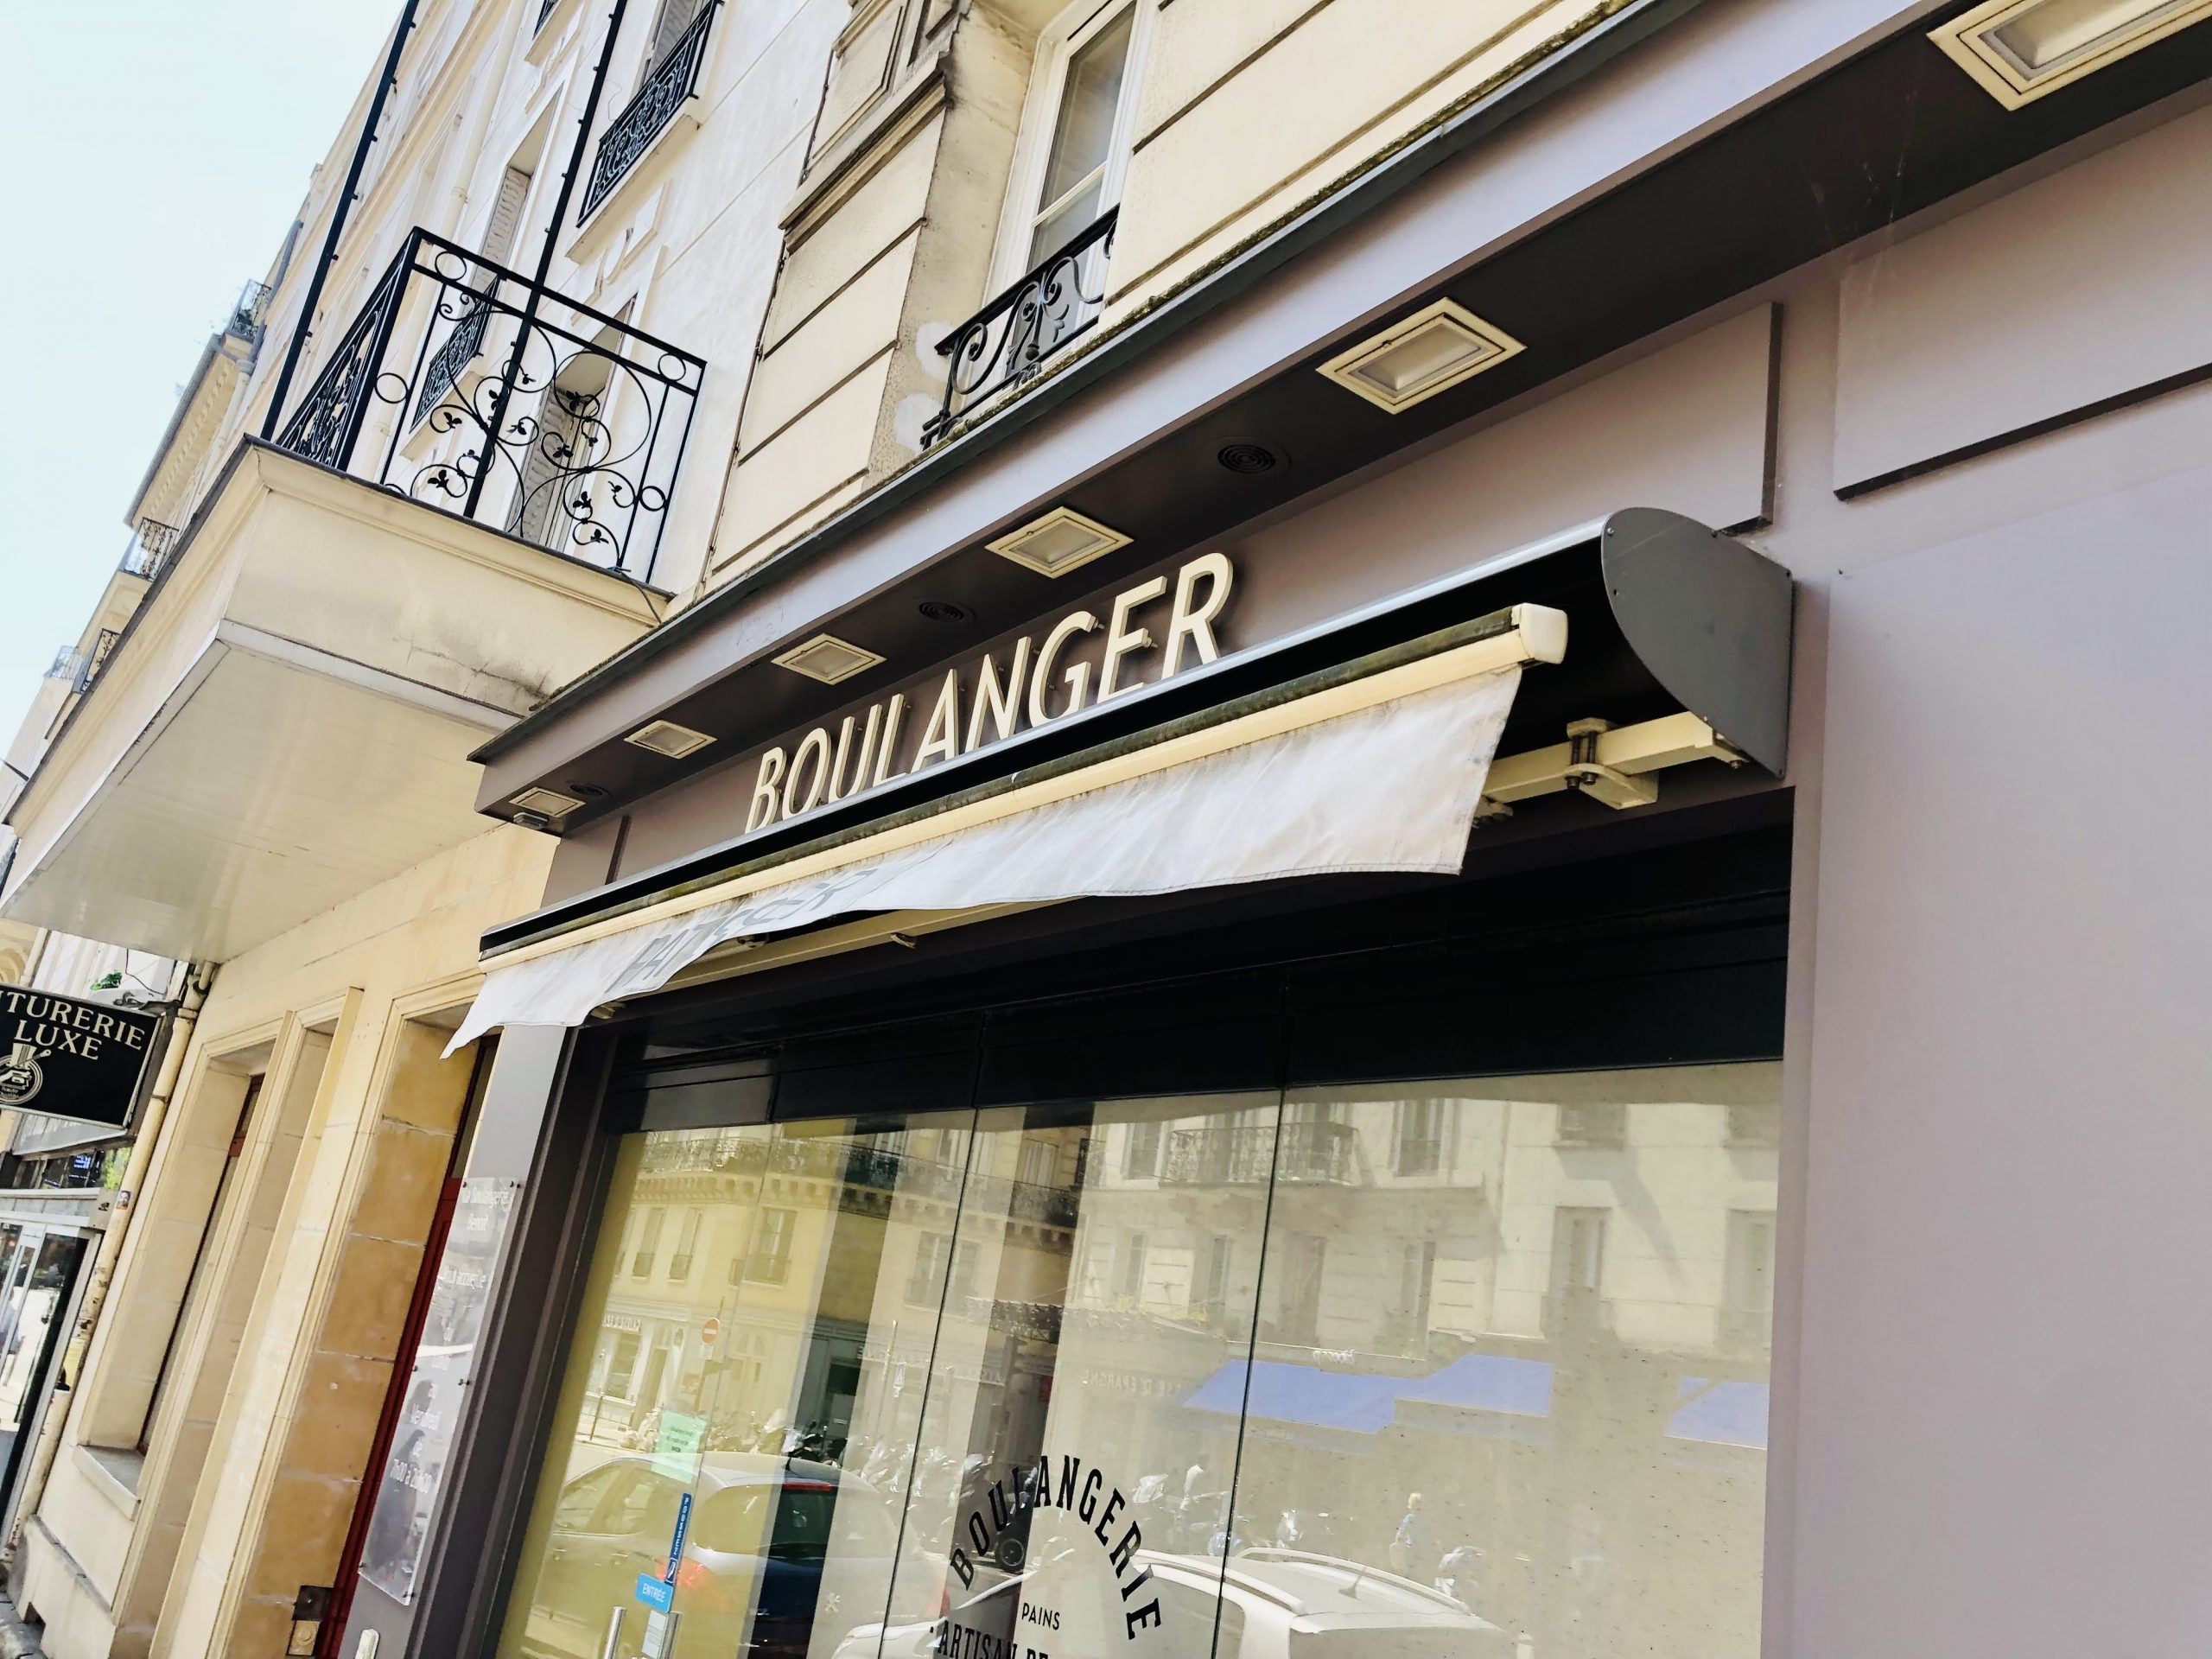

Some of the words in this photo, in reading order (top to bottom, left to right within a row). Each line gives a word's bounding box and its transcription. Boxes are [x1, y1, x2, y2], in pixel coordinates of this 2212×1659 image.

[744, 553, 1233, 835] BOULANGER
[0, 990, 145, 1051] TURERIE
[14, 1020, 102, 1060] LUXE
[950, 1454, 1162, 1640] BOULANGERIE
[1021, 1602, 1061, 1630] PAINS
